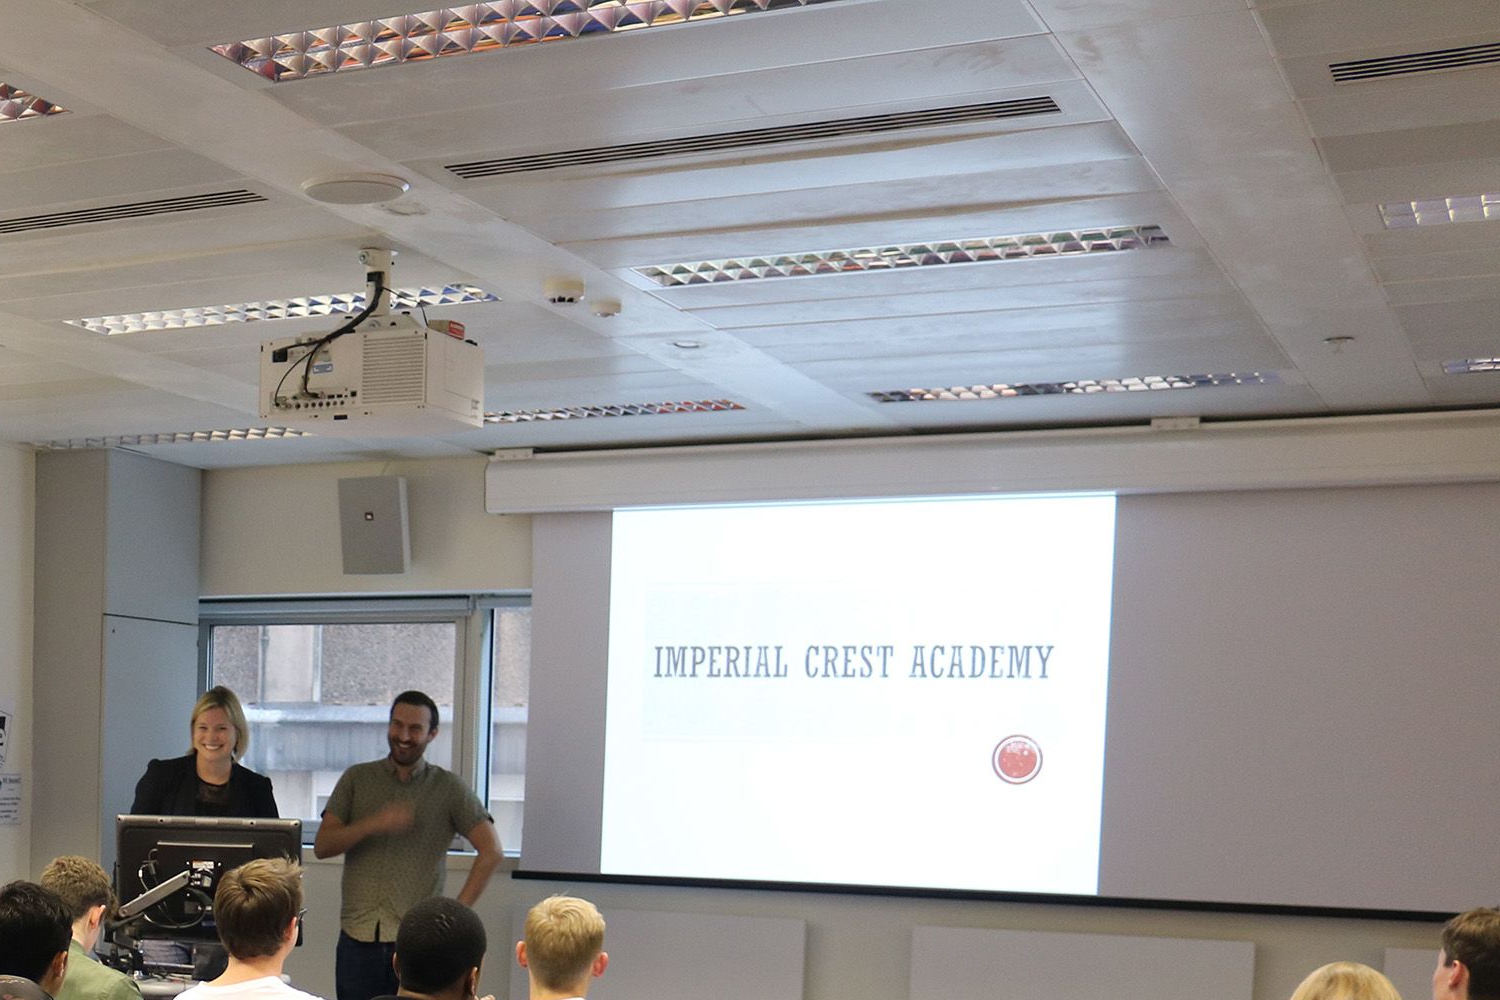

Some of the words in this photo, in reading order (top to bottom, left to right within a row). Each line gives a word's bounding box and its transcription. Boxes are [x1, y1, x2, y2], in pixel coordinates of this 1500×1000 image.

[653, 645, 788, 678] IMPERIAL
[805, 644, 894, 678] CREST
[909, 644, 1055, 679] ACADEMY
